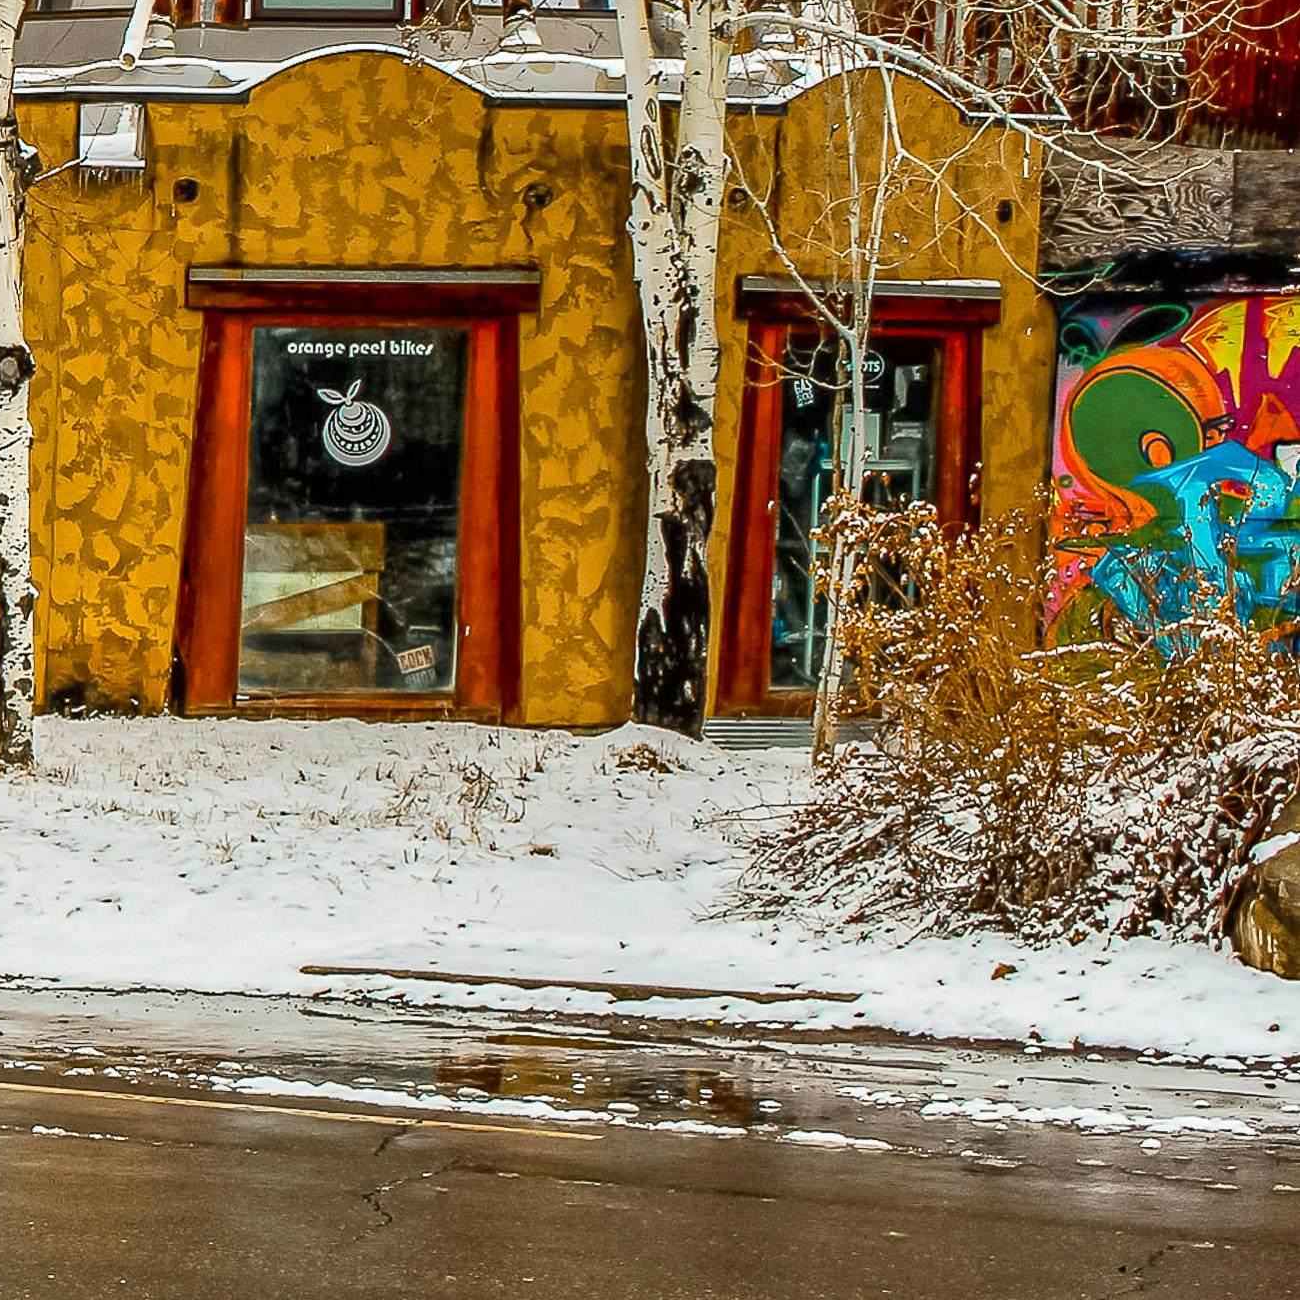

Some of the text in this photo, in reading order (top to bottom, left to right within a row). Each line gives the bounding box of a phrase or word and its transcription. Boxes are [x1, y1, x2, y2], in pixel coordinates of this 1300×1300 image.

[287, 340, 434, 358] orange peel bikes
